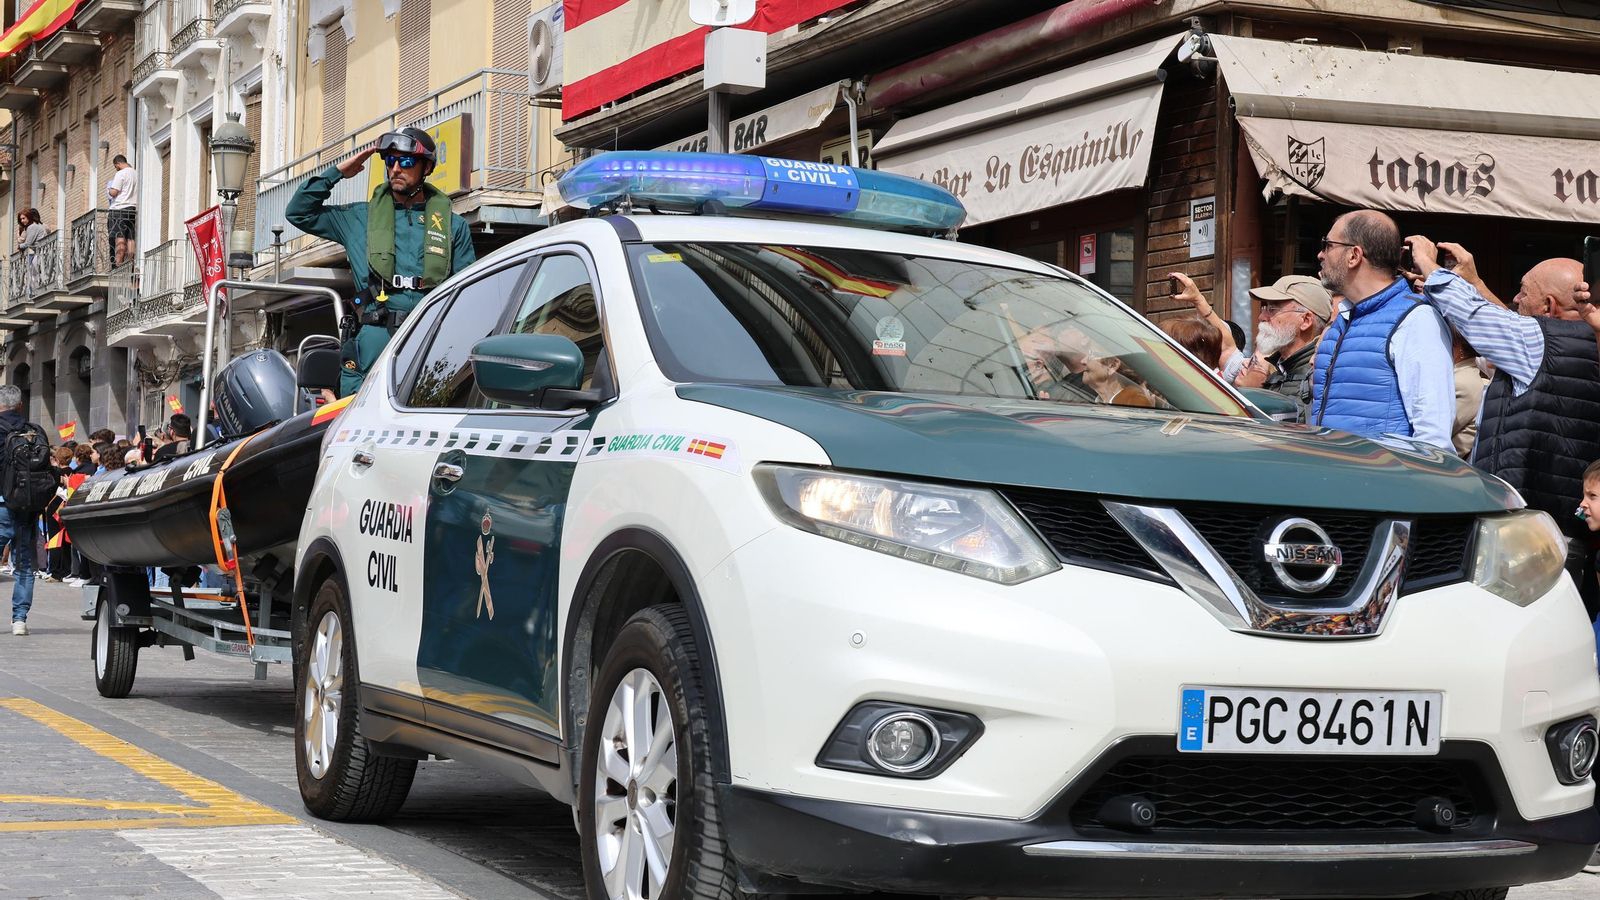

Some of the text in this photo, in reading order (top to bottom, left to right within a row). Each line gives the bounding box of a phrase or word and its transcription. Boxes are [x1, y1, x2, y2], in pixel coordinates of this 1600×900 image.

[733, 115, 768, 151] BAR
[765, 158, 850, 175] GUARDIA
[984, 155, 1011, 193] La
[787, 169, 837, 185] CIVIL
[1367, 146, 1496, 208] tapas
[1194, 204, 1213, 214] SECTOR
[427, 230, 446, 239] GUARDIA
[222, 391, 243, 434] YAMAHA
[607, 434, 686, 452] GUARDIA CIVIL
[359, 498, 413, 544] GUARDIA
[1276, 546, 1336, 564] NISSAN
[367, 550, 398, 593] CIVIL
[1186, 727, 1198, 740] E
